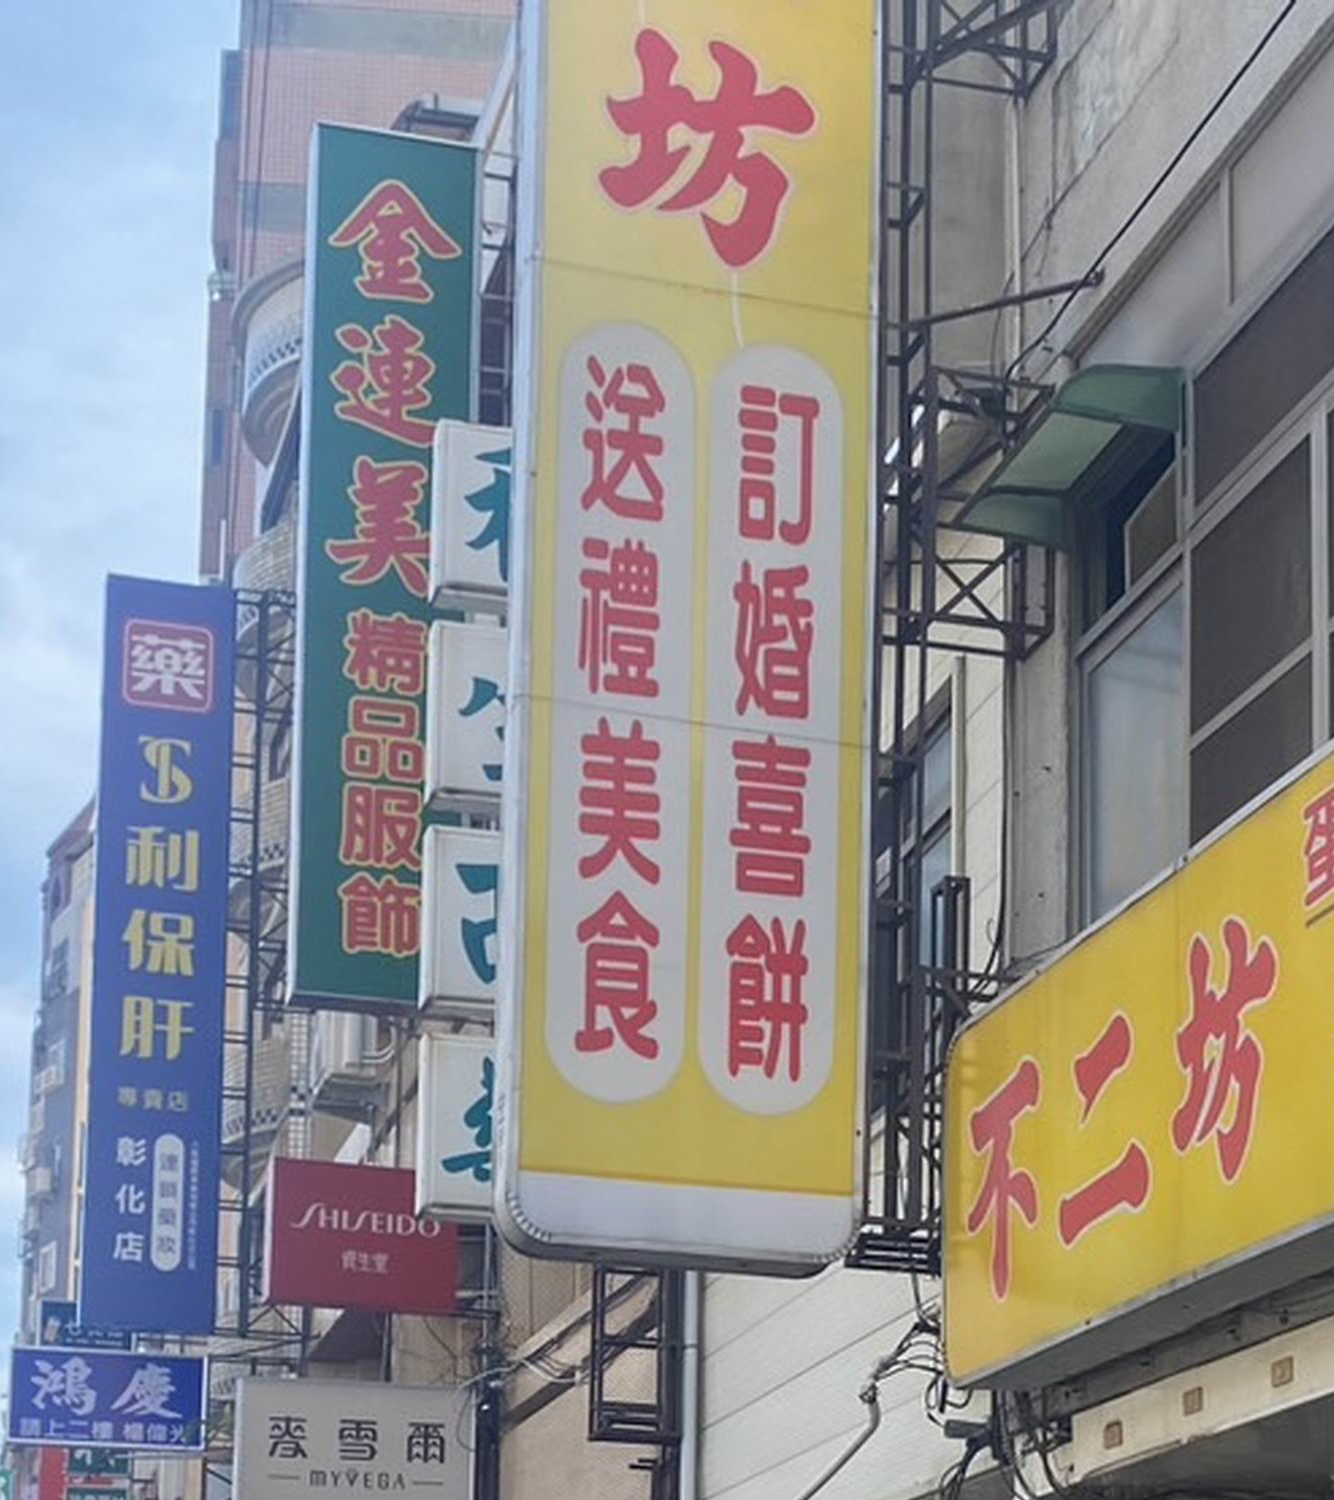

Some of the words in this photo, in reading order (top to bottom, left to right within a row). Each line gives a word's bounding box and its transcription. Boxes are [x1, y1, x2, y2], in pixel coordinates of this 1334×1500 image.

[597, 27, 816, 269] 坊
[327, 179, 463, 955] 金連美精品服飾
[130, 632, 206, 700] 藥
[574, 354, 668, 1062] 送禮美食
[725, 383, 821, 1085] 訂婚喜餅
[964, 916, 1280, 1303] 不二坊
[113, 1136, 147, 1262] 彰化店
[290, 1202, 442, 1239] SHISEIDO
[341, 1249, 389, 1276] 資生堂
[30, 1356, 183, 1419] 鴻慶
[267, 1415, 447, 1464] 麥雪爾
[309, 1468, 407, 1491] MYVEGA
